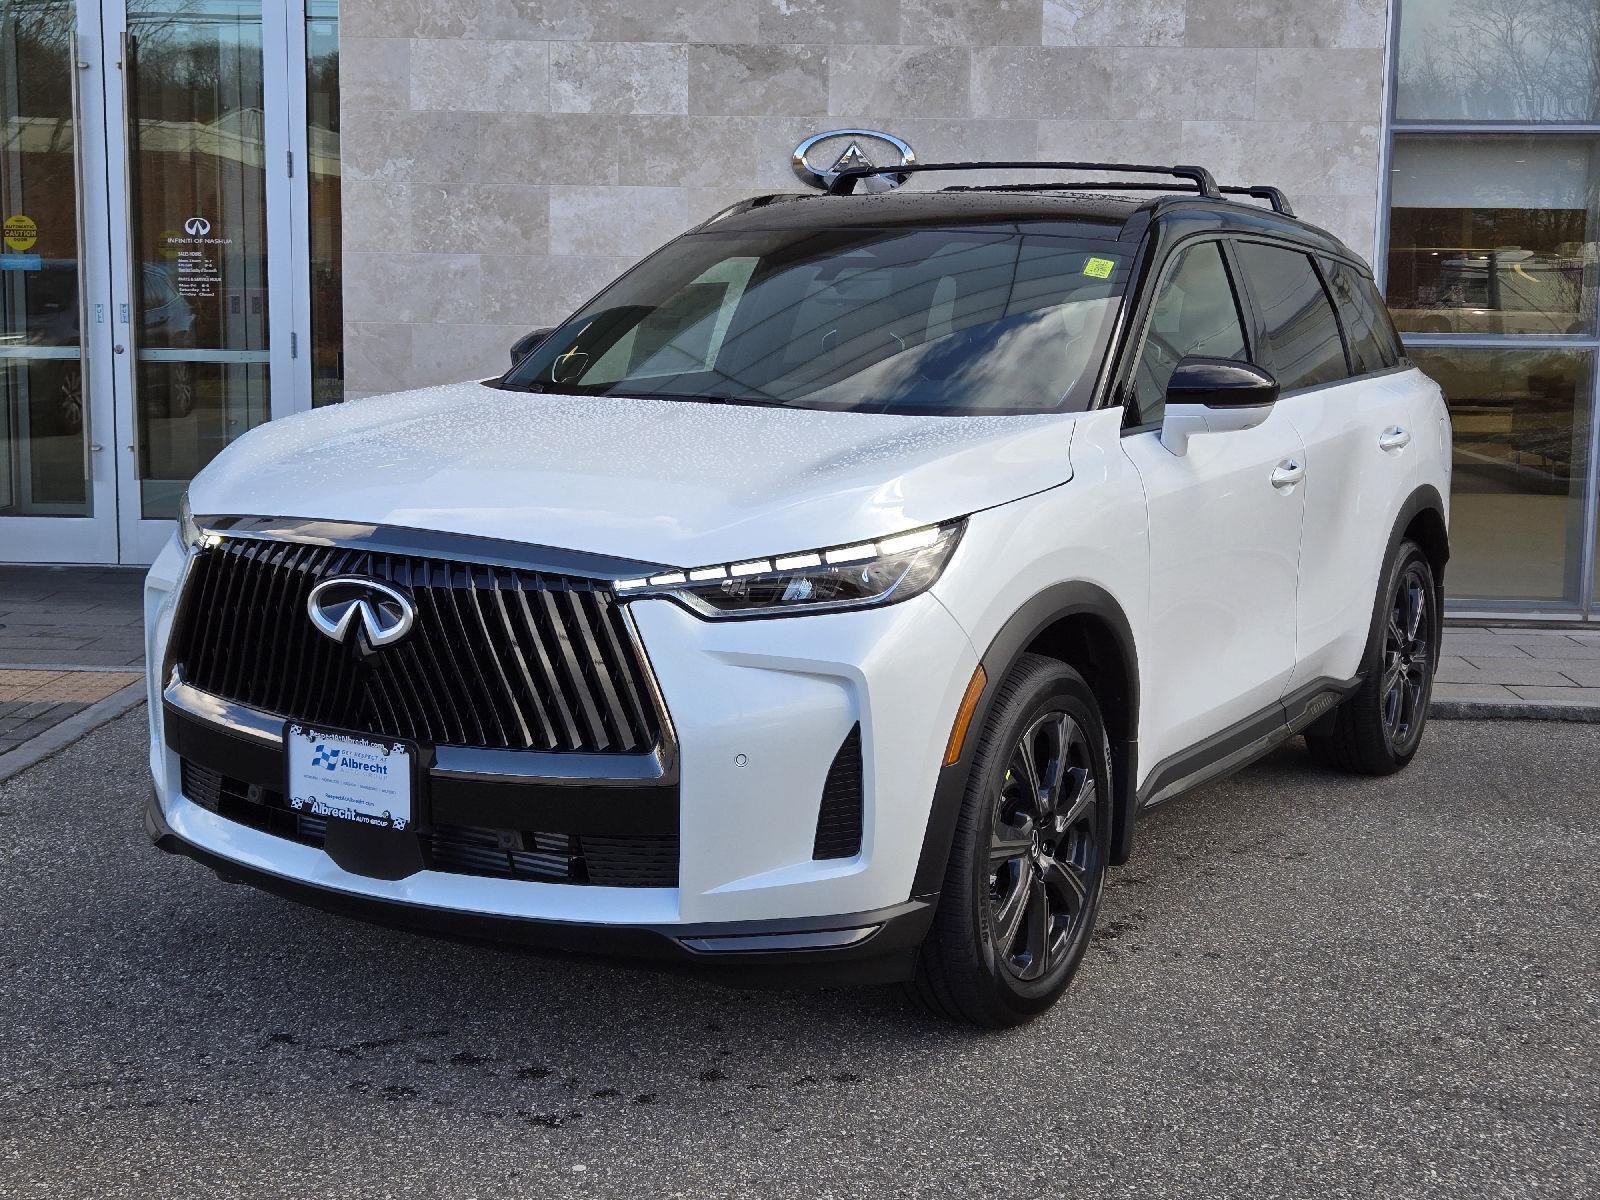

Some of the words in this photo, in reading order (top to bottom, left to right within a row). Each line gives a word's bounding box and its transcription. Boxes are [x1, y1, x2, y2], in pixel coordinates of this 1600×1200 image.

[340, 757, 388, 775] Albrecht
[355, 752, 379, 762] RESPECT
[310, 801, 356, 821] Albrecht
[370, 817, 388, 827] GROUP
